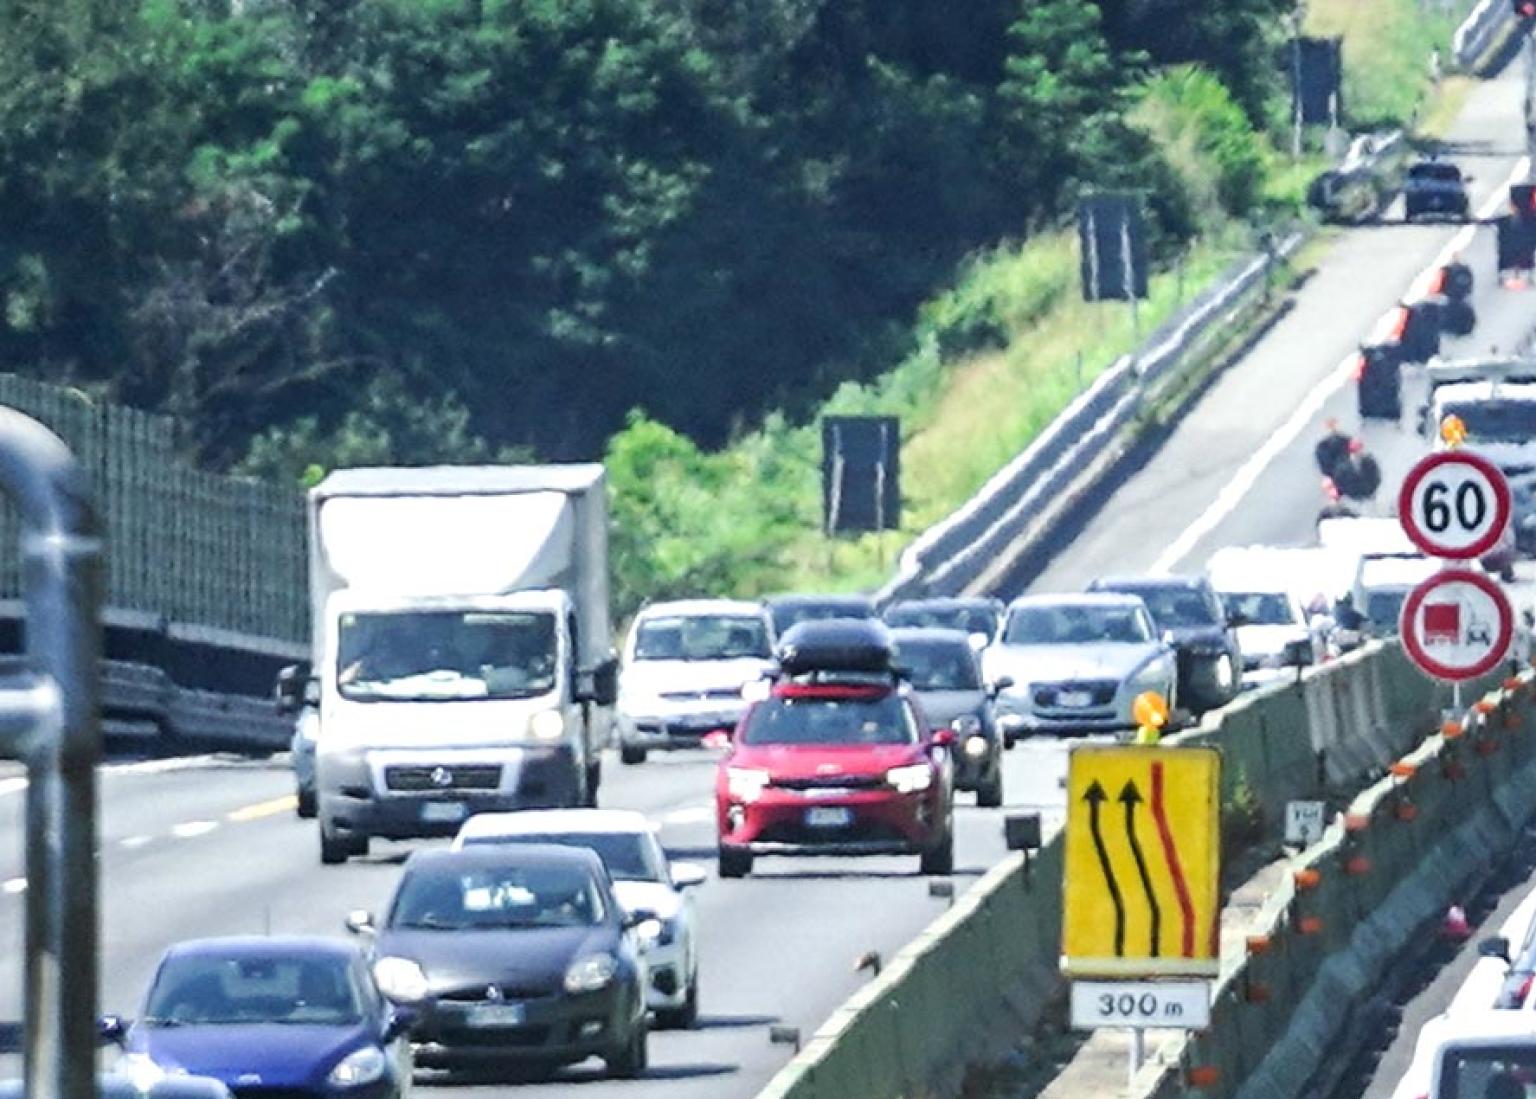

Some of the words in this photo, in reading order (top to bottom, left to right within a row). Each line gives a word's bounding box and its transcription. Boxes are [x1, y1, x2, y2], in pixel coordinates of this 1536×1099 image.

[1422, 480, 1486, 533] 60
[1098, 992, 1158, 1017] 300
[1164, 1001, 1185, 1017] m
